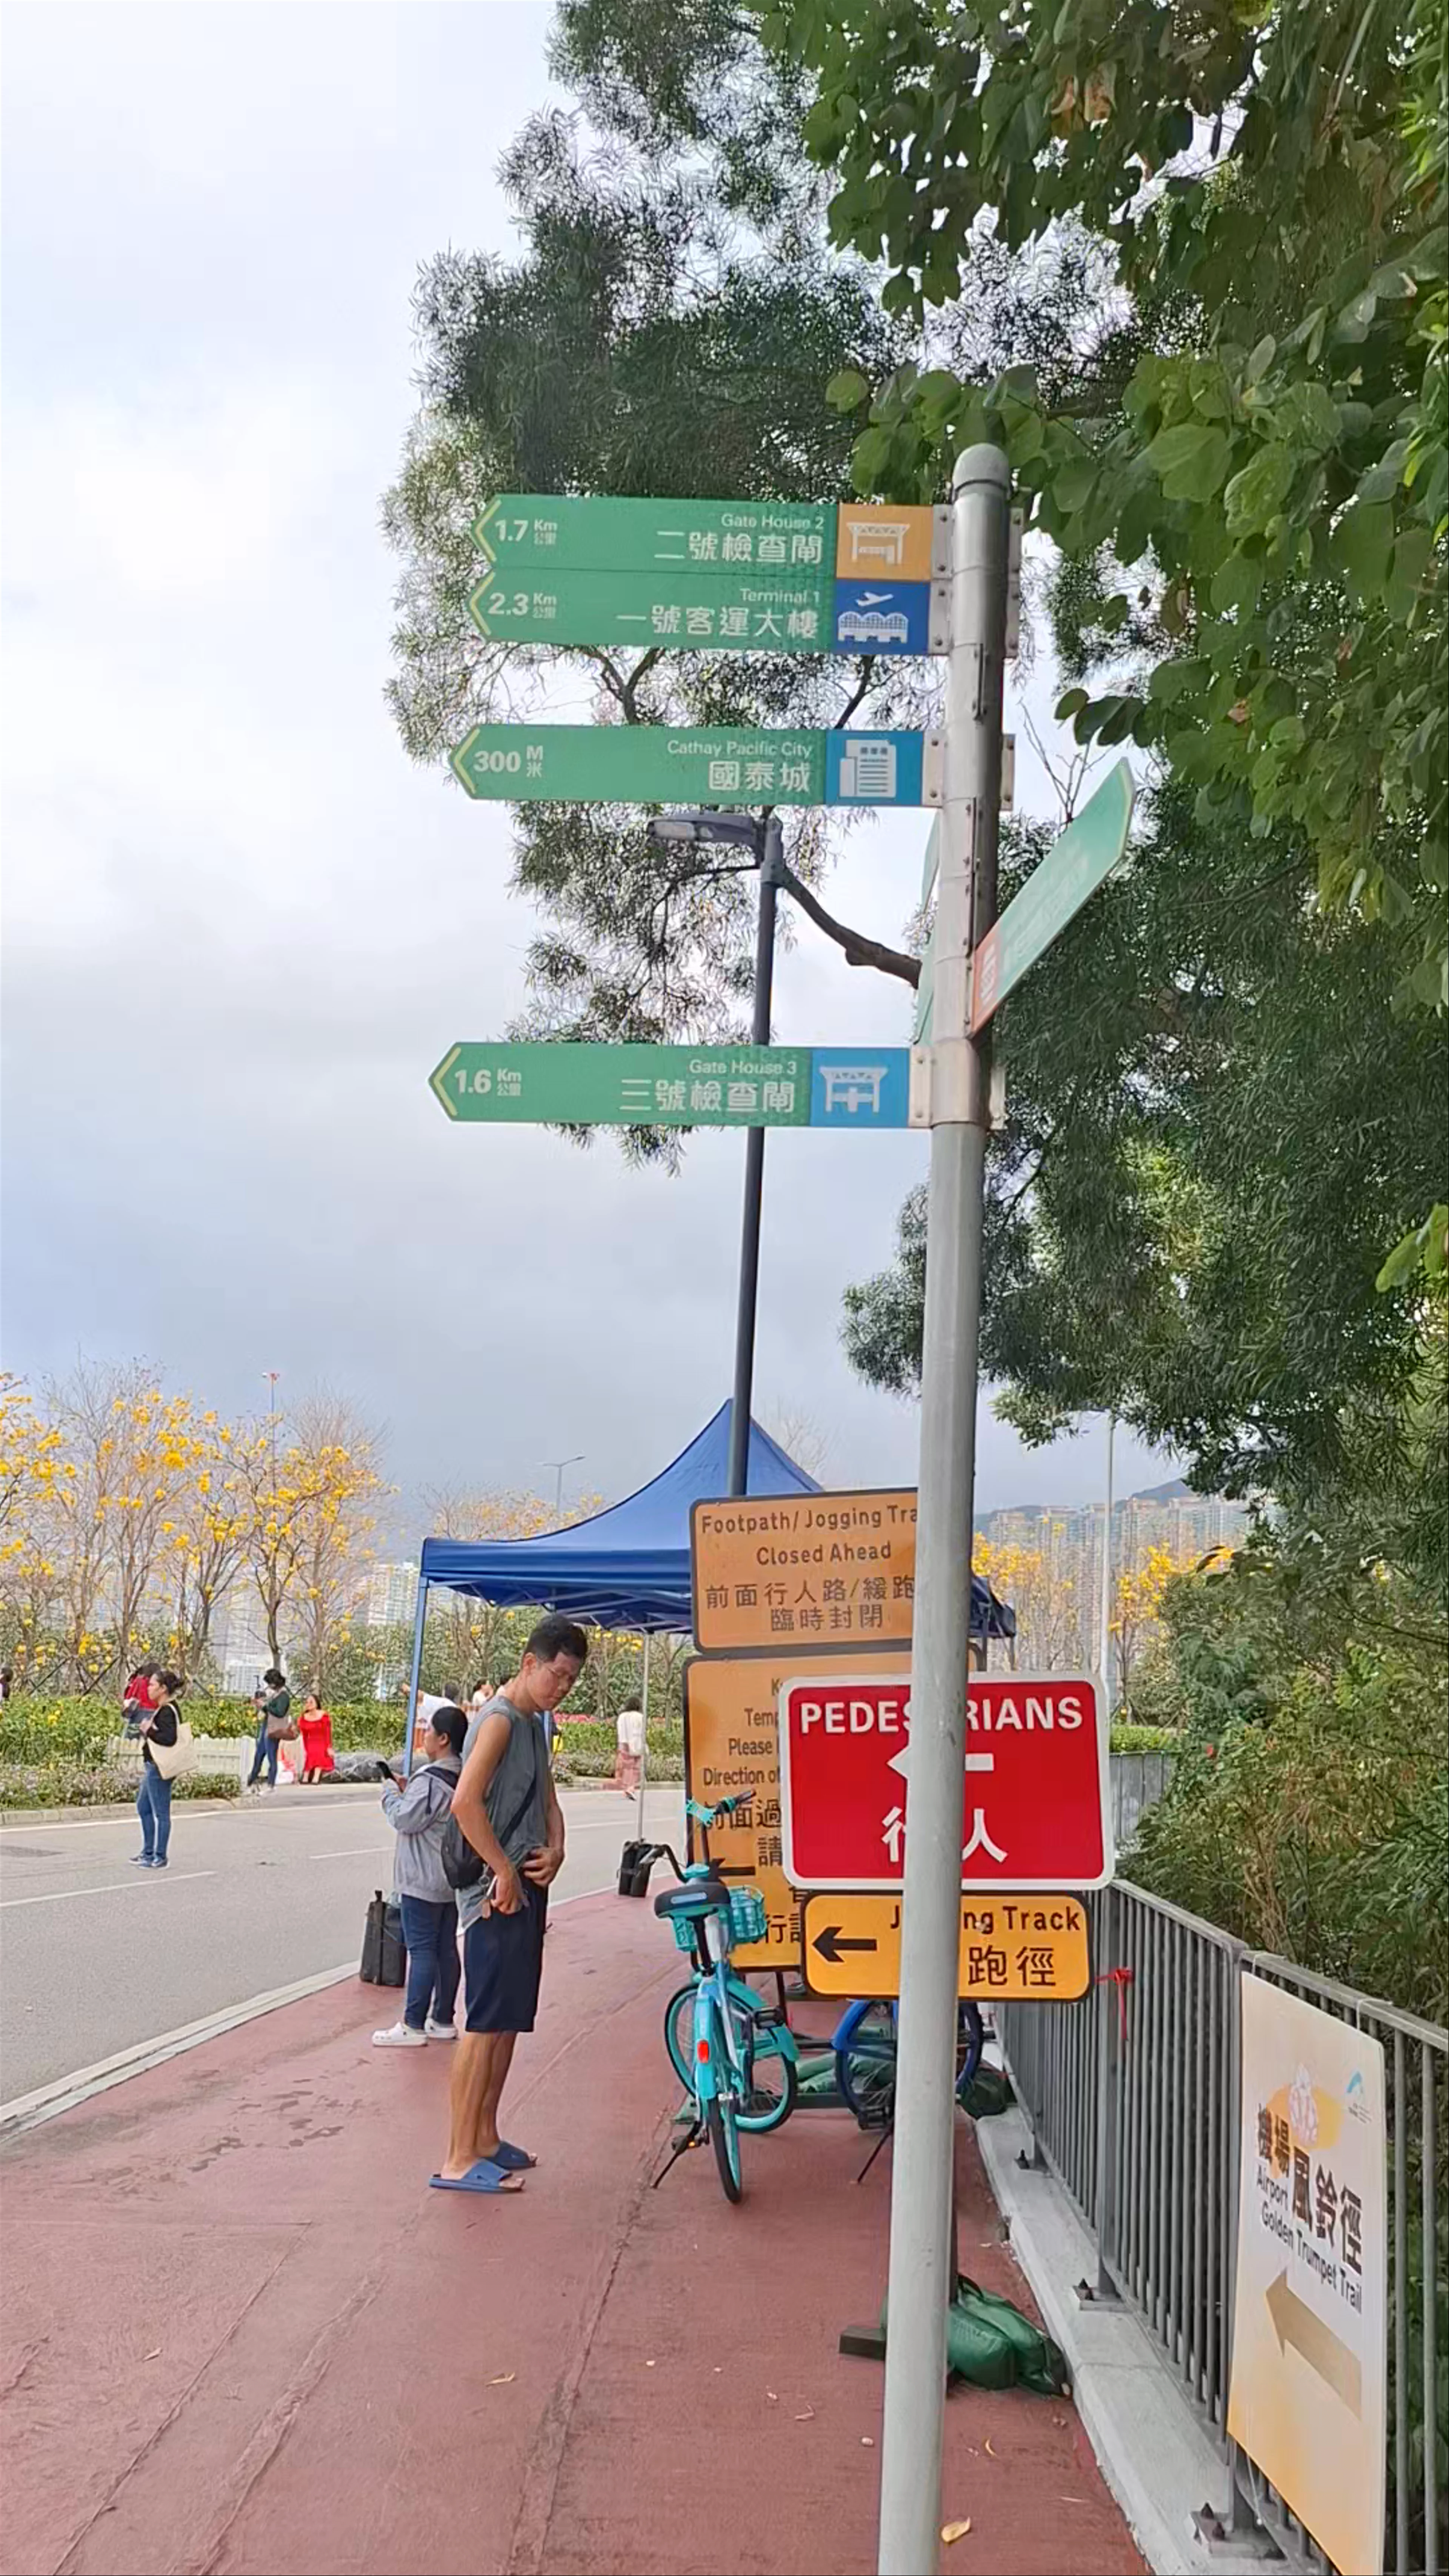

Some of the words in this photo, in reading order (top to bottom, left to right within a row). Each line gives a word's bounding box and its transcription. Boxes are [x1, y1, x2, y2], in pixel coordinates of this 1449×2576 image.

[494, 519, 529, 542] 1.7
[534, 518, 558, 531] Km
[721, 514, 756, 528] Gate
[761, 516, 811, 529] House
[814, 517, 824, 529] 2
[654, 531, 822, 564] 二號檢查閘
[487, 592, 529, 615] 2.3
[533, 592, 557, 605] Km
[740, 588, 808, 603] Terminal
[814, 591, 820, 602] 1
[616, 604, 819, 639] 一號客運大樓
[473, 750, 521, 773] 300
[526, 746, 543, 760] M
[667, 740, 720, 758] Cathay
[726, 741, 778, 756] Pacific
[781, 742, 812, 758] City
[526, 762, 542, 778] 米
[708, 761, 811, 792] 國泰城
[689, 1060, 726, 1074] Gate
[731, 1061, 783, 1074] House
[787, 1061, 797, 1074] 3
[454, 1069, 491, 1094] 1.6
[497, 1068, 521, 1081] Km
[619, 1079, 794, 1113] 三號檢查閘
[887, 1504, 918, 1524] Tra
[756, 1544, 823, 1565] Closed
[830, 1541, 892, 1563] Ahead
[706, 1576, 915, 1610] 前面行人路/緩跑
[771, 1604, 883, 1632] 臨時封閉
[800, 1696, 1083, 1734] PEDERIANS
[728, 1738, 773, 1756] Please
[703, 1766, 764, 1786] Direction
[1003, 1905, 1081, 1932] Track
[1257, 2164, 1288, 2212] Airport
[1261, 2199, 1294, 2250] Golden
[1297, 2227, 1337, 2290] Trumpet
[1340, 2267, 1362, 2315] Trail
